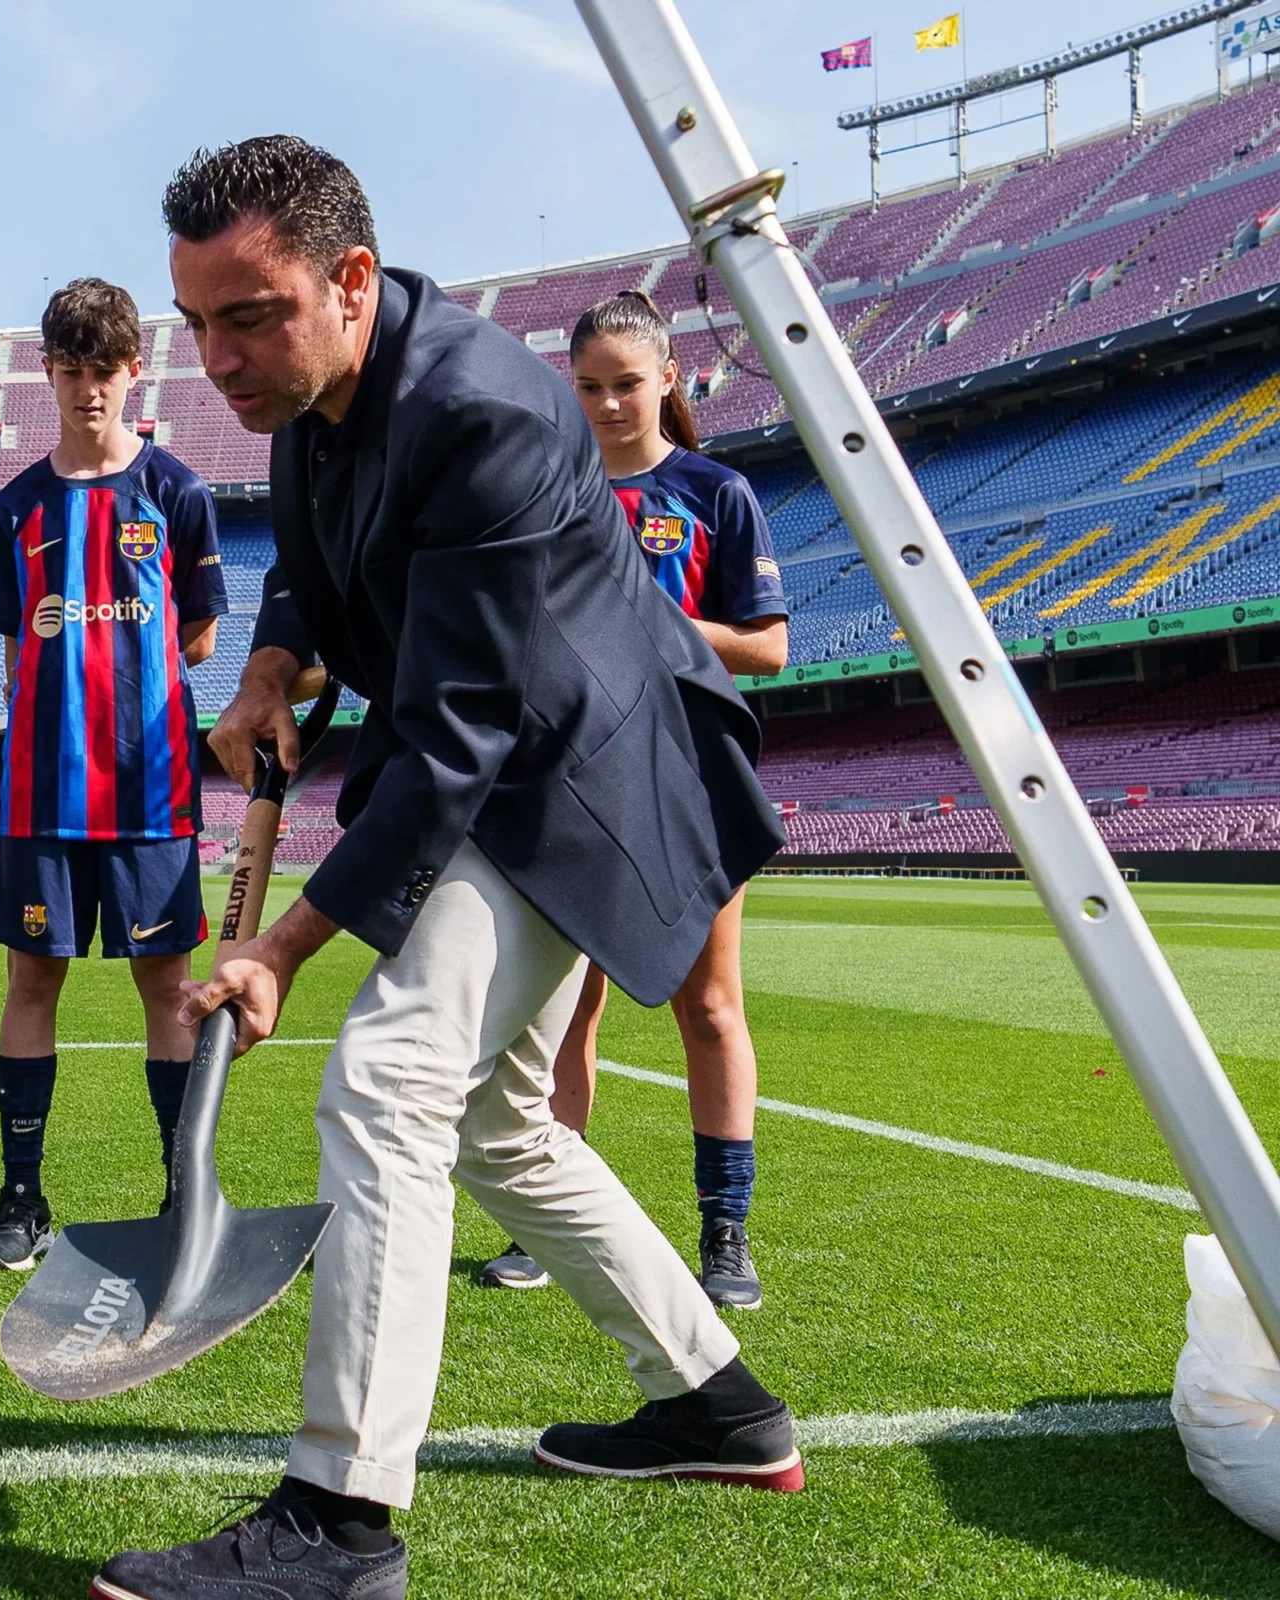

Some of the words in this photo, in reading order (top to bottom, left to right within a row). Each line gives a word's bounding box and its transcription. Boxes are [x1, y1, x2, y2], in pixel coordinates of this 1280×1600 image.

[64, 596, 154, 626] Spotify
[1246, 605, 1275, 619] Spotify
[1080, 630, 1101, 642] Spotify
[1161, 618, 1186, 632] Spotify
[220, 866, 251, 941] BELLOTA
[46, 1277, 137, 1367] BELLOTA
